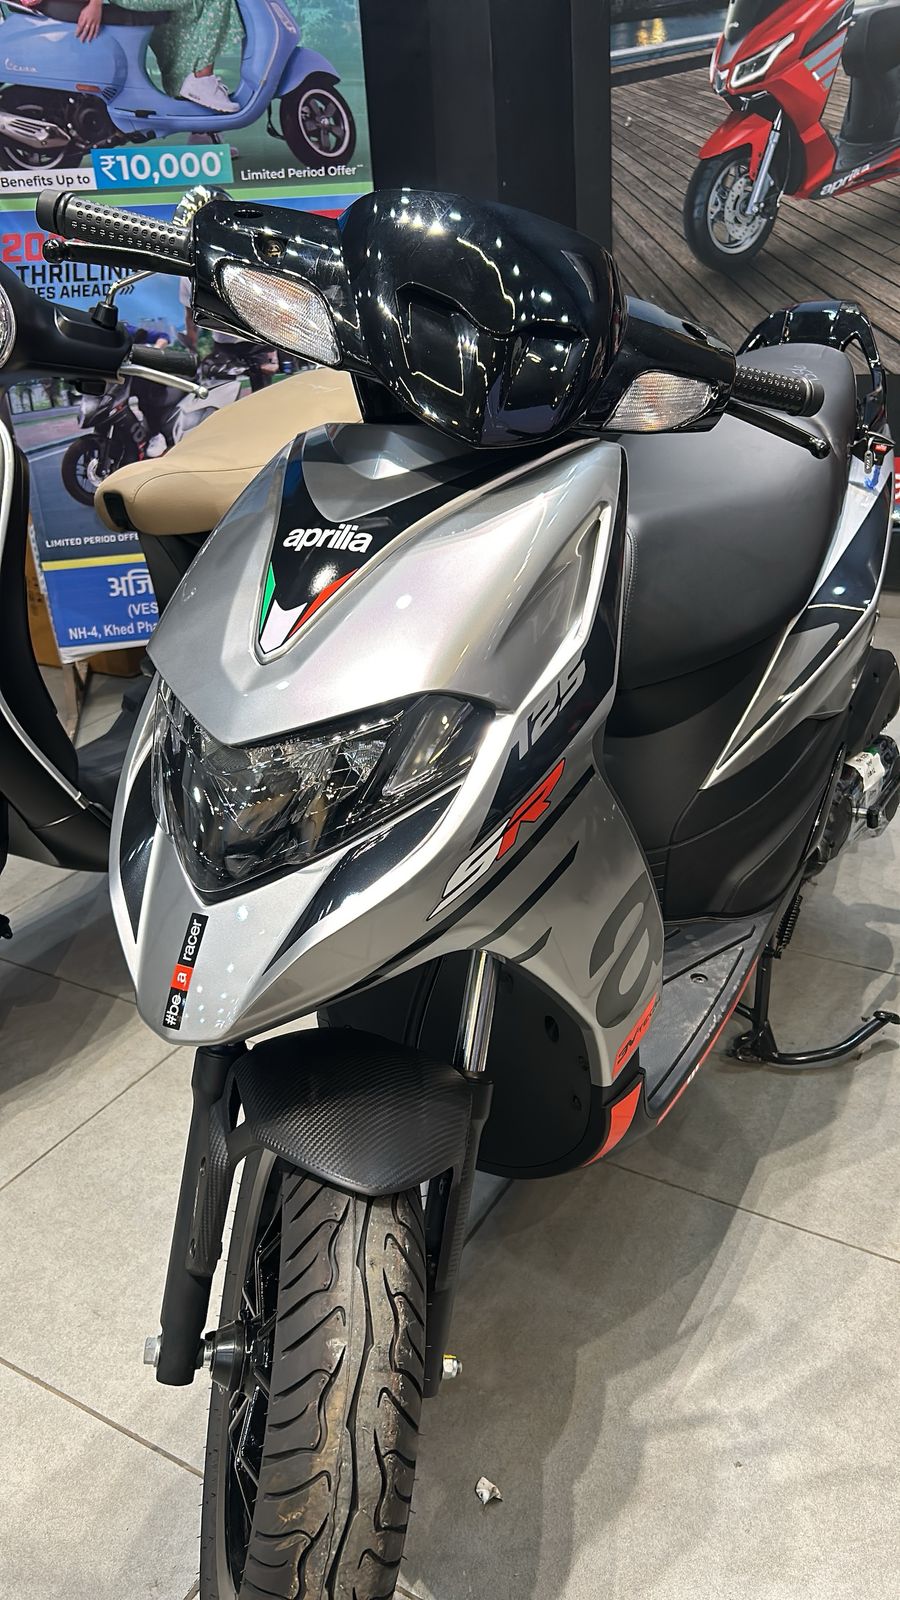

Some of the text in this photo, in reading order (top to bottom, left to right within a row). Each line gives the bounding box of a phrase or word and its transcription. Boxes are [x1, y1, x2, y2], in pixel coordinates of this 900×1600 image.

[1, 175, 91, 188] Benefits Up to
[241, 168, 286, 181] Limited
[288, 166, 326, 179] Period
[45, 538, 82, 548] LIMITED
[84, 535, 116, 545] PERIOD
[283, 523, 373, 554] aprilia
[128, 602, 159, 619] (VES
[69, 626, 102, 640] NH-4,
[104, 622, 135, 636] Khed
[511, 659, 587, 761] 125
[426, 757, 566, 922] SR
[165, 919, 202, 1026] #be a racer
